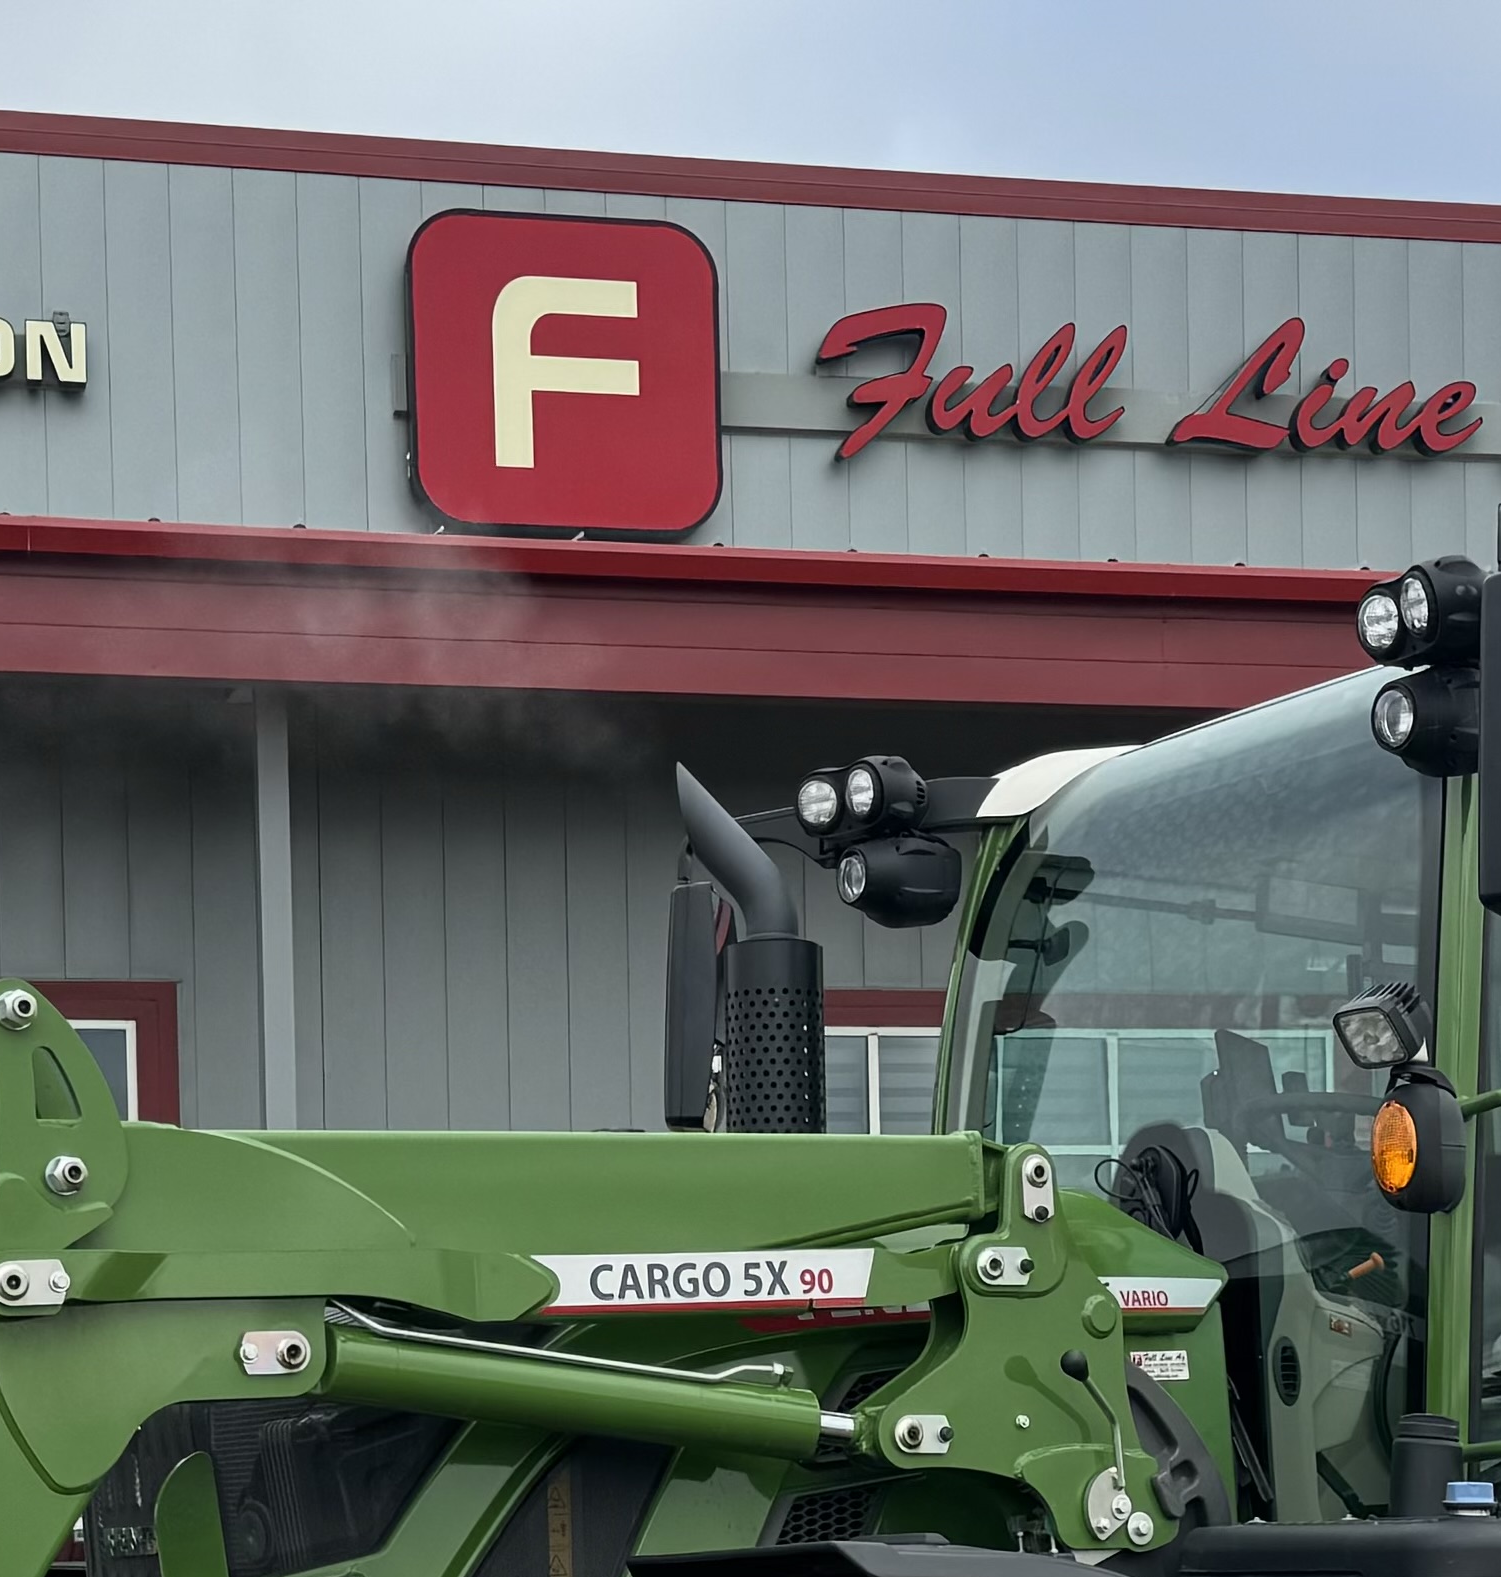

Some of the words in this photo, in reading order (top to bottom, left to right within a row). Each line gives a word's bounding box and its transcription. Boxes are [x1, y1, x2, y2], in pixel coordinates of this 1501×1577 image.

[491, 275, 640, 469] F
[815, 301, 1128, 462] Full
[1167, 316, 1483, 455] Line
[590, 1260, 731, 1302] CARGO
[743, 1260, 792, 1297] 5X
[799, 1269, 834, 1295] 90
[1119, 1289, 1169, 1307] VARIO
